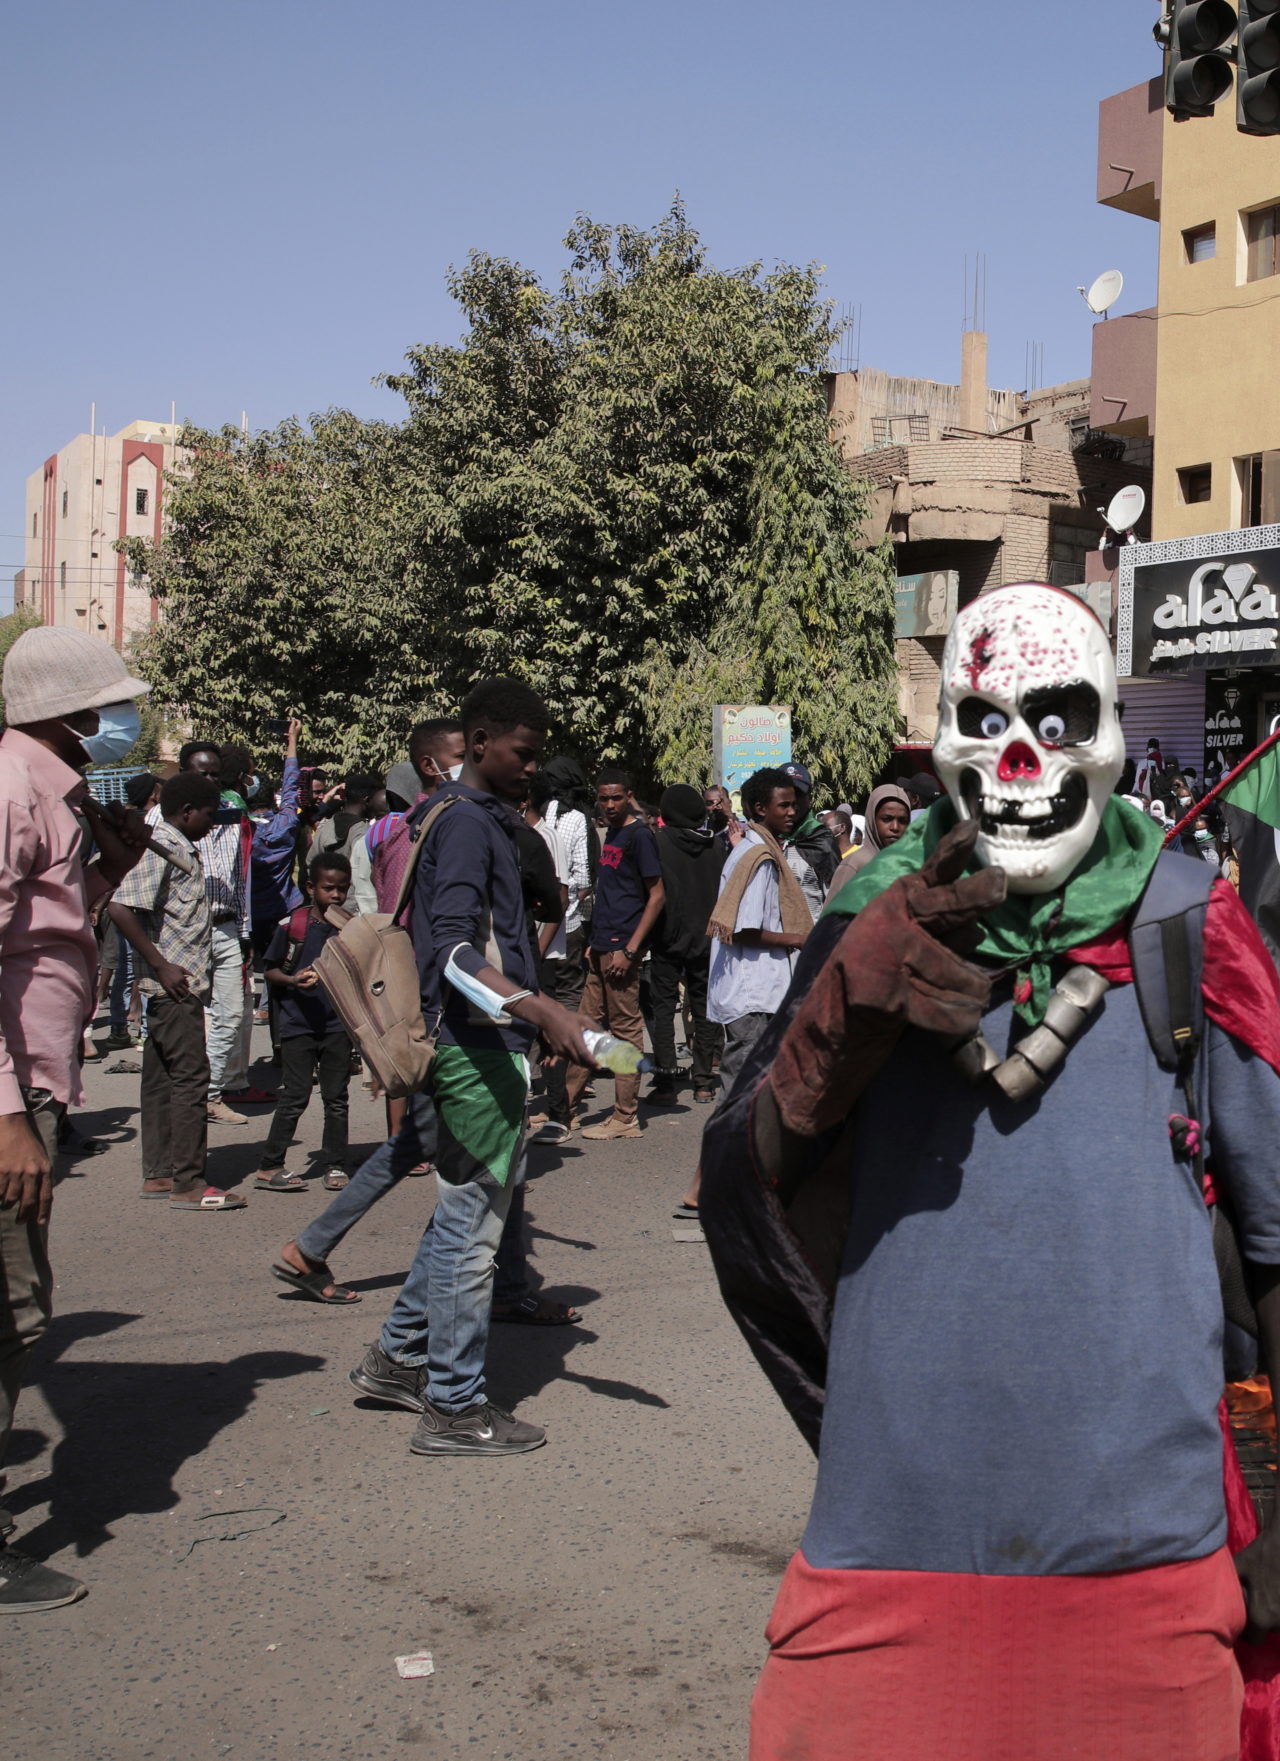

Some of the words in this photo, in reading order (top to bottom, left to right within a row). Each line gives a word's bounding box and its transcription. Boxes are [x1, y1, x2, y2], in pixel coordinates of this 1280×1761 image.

[1195, 627, 1279, 654] SILVER
[739, 716, 773, 729] صالون
[1205, 733, 1244, 748] SILVER
